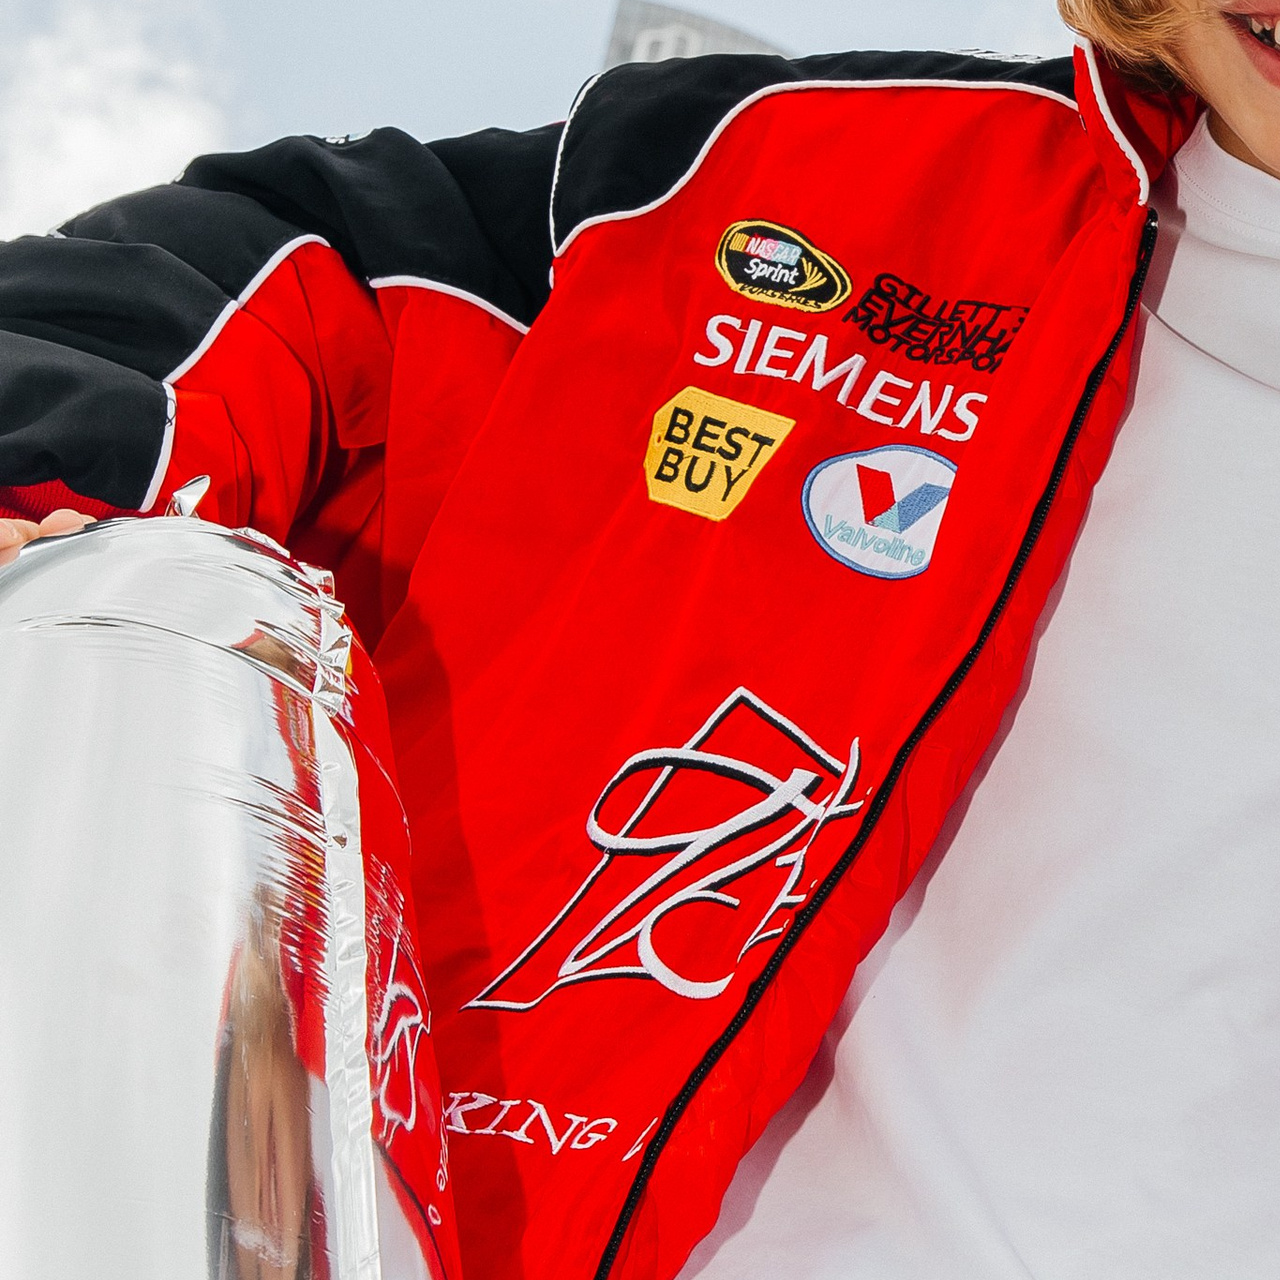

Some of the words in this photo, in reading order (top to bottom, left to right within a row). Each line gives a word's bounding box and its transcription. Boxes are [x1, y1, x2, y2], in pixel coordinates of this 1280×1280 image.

[744, 258, 800, 285] Sprint
[745, 236, 801, 264] NASCAR
[694, 313, 989, 443] SIEMENS
[664, 406, 775, 469] BEST
[654, 451, 751, 502] BUY
[823, 513, 927, 567] Valvoline
[445, 1091, 619, 1156] KING
